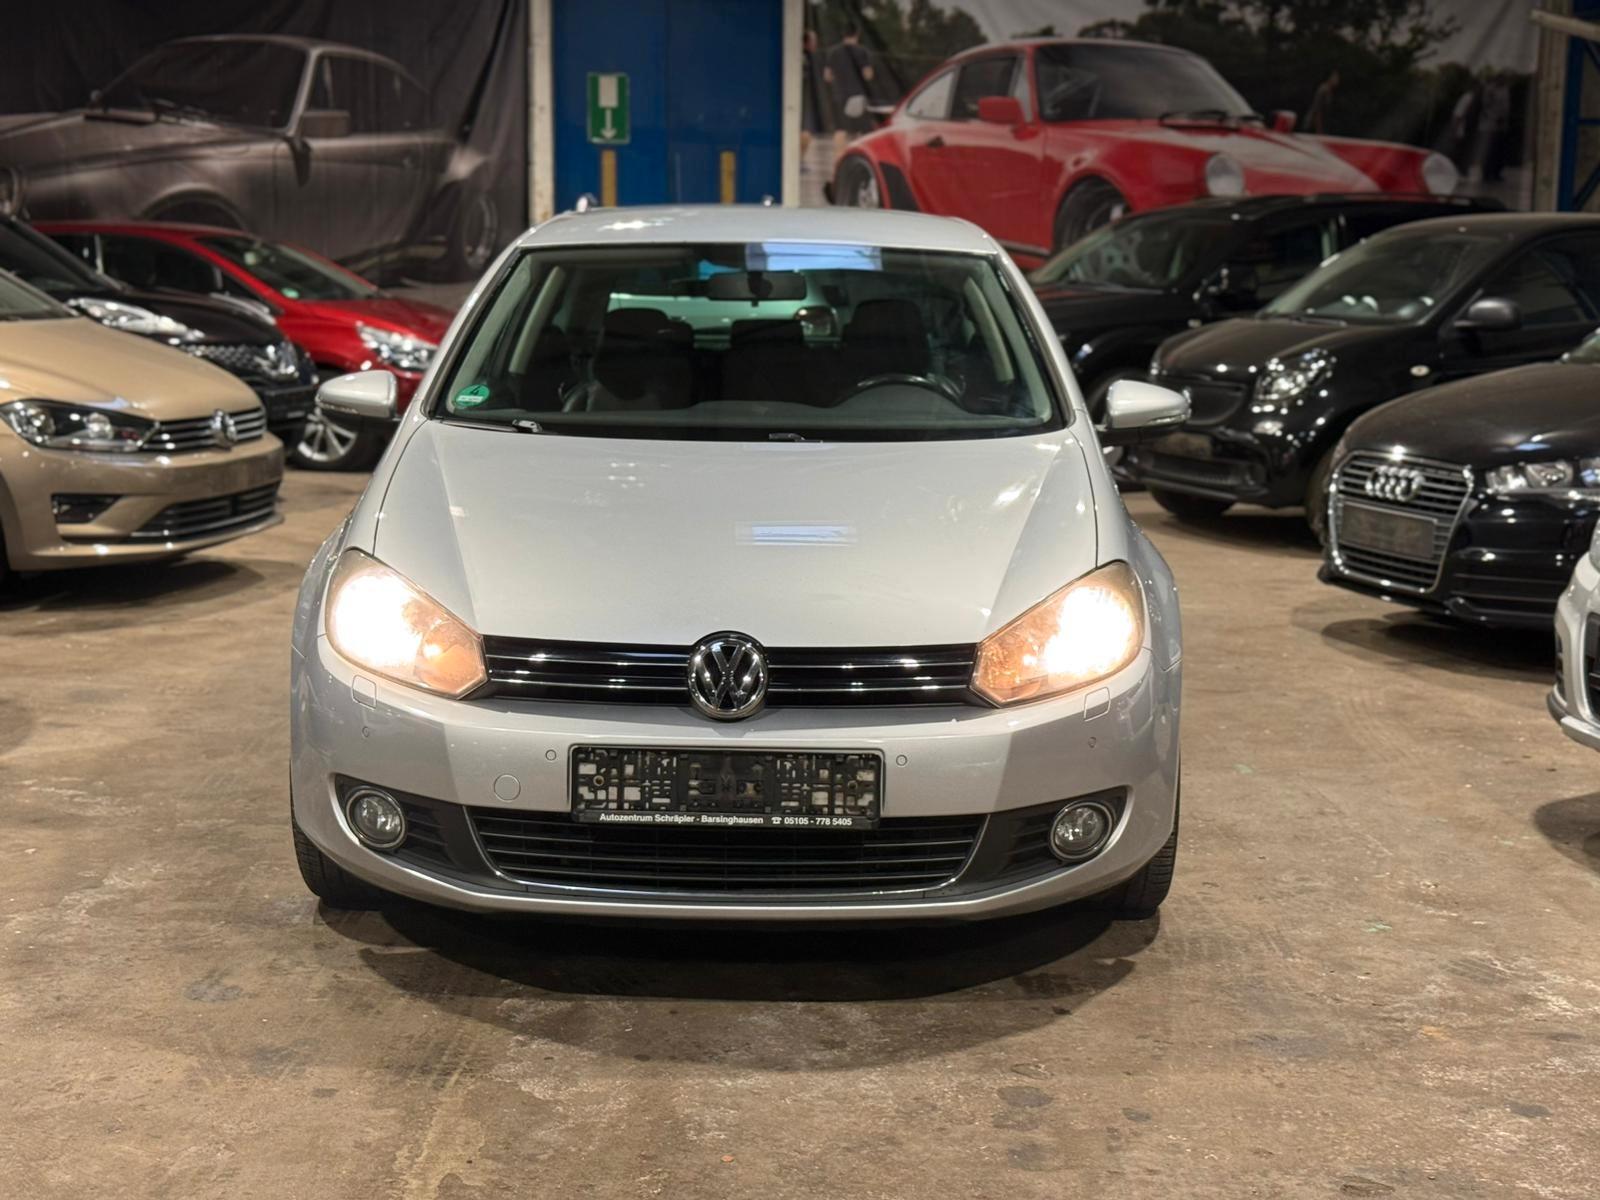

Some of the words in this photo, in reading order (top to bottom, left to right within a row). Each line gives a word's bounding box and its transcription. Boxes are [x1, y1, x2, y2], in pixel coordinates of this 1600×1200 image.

[470, 385, 481, 396] 4
[599, 813, 653, 822] Autozentrum
[701, 815, 764, 825] Barsinghausen
[784, 816, 809, 825] 05105
[815, 817, 831, 826] 778
[832, 818, 853, 826] 5405
